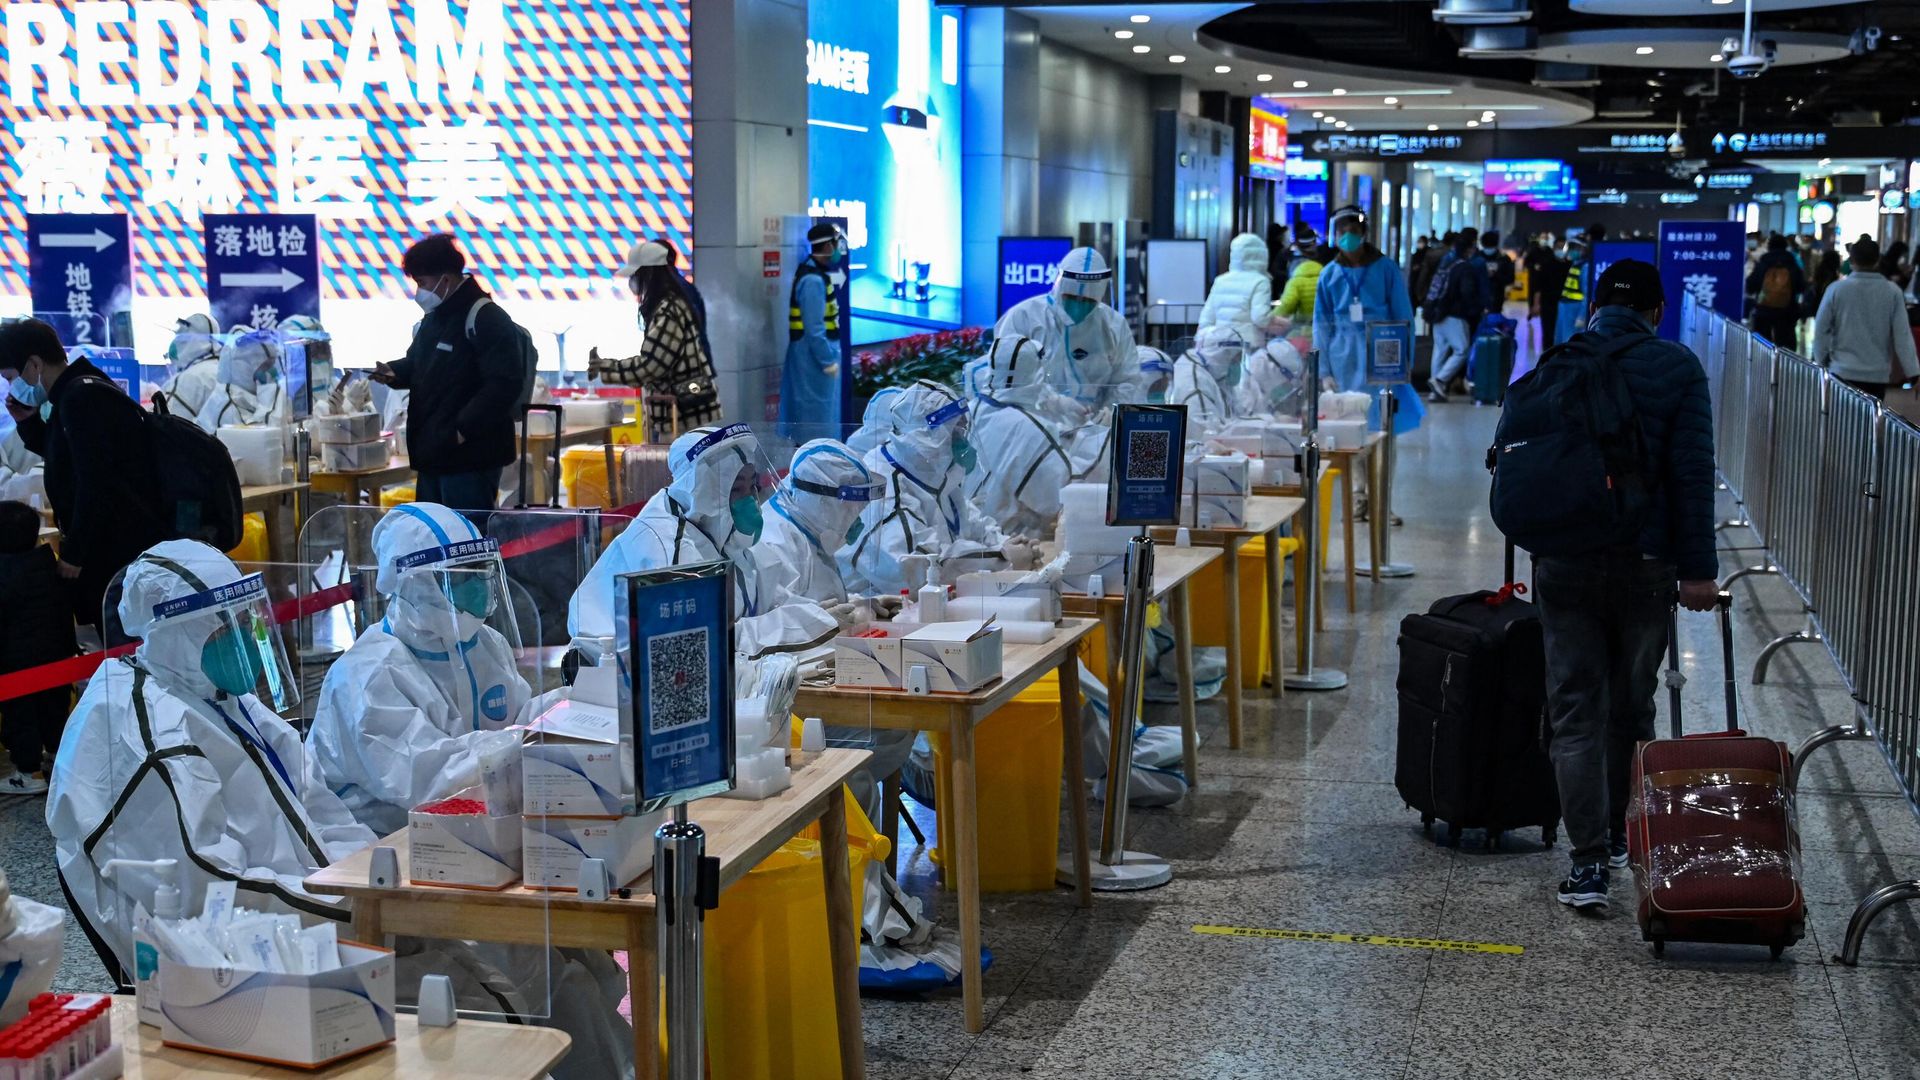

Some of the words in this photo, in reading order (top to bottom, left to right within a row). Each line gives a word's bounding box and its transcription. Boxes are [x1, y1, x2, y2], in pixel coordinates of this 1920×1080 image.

[6, 0, 508, 105] REDREAM
[14, 112, 508, 223] 薇琳医美
[214, 225, 308, 257] 落地检
[1614, 281, 1631, 289] POLO
[659, 598, 697, 618] 场所码
